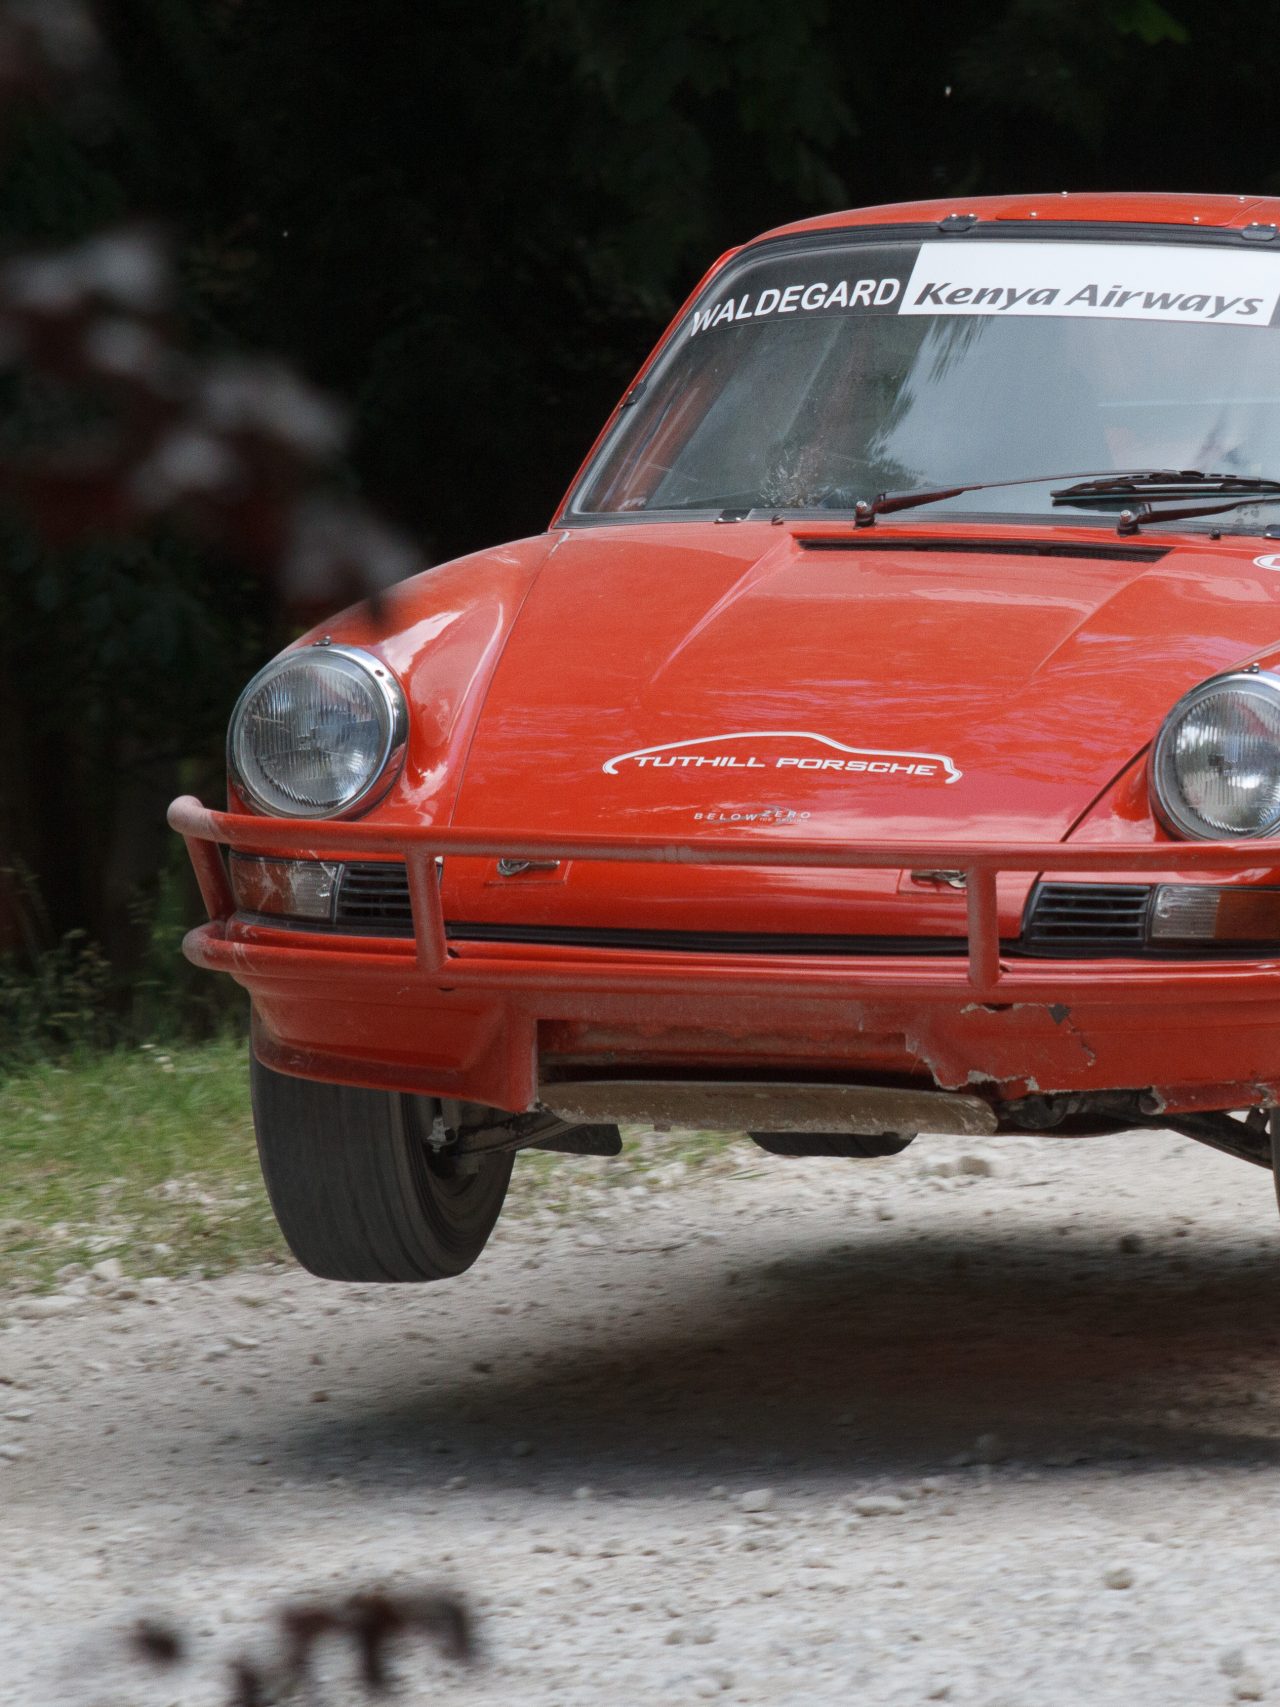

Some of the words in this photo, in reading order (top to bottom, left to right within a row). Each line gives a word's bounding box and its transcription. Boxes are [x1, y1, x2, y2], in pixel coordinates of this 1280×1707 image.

[690, 277, 900, 338] WALDEGARD
[914, 281, 1060, 313] Kenya
[1068, 284, 1266, 319] Airways
[633, 756, 765, 769] TUTHILL
[776, 757, 937, 776] PORSCHE
